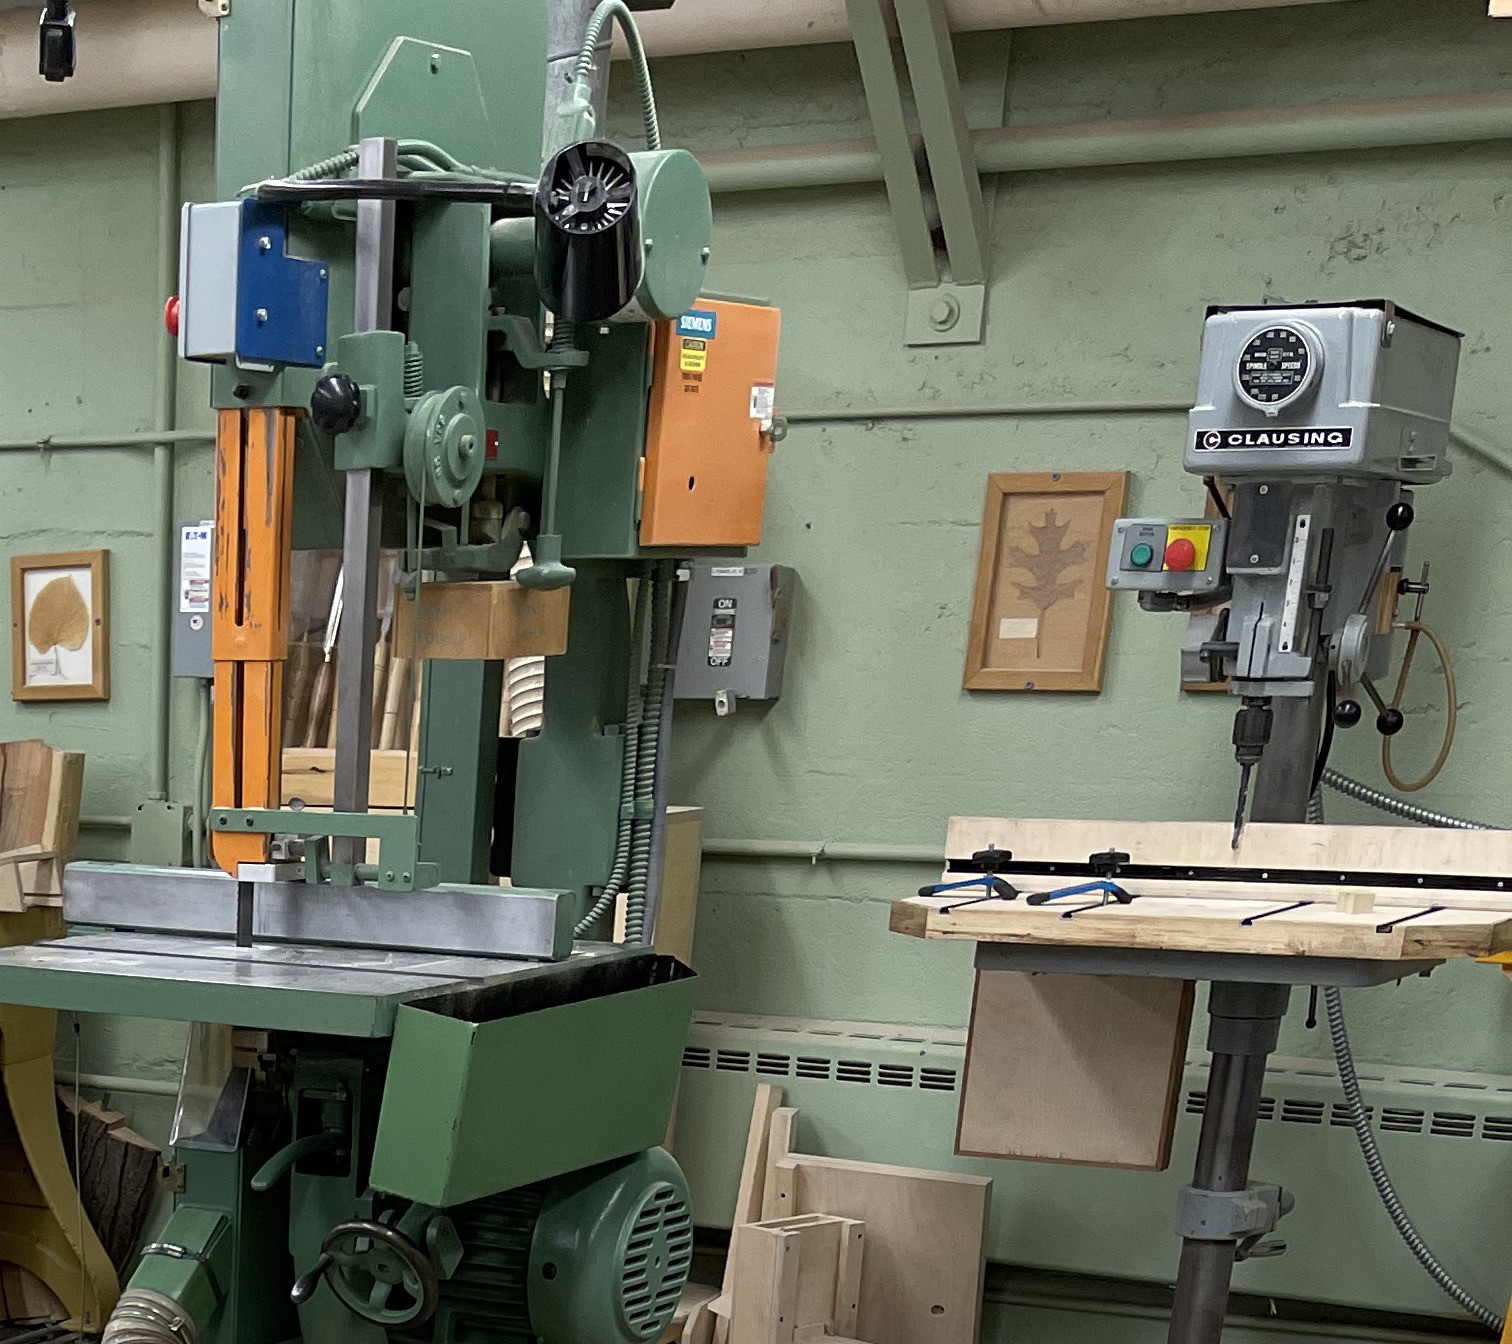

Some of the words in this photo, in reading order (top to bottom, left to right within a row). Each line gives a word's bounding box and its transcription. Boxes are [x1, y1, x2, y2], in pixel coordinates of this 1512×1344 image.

[680, 315, 712, 331] SIEMENS
[1228, 432, 1343, 445] CLAUSING
[717, 599, 733, 609] ON
